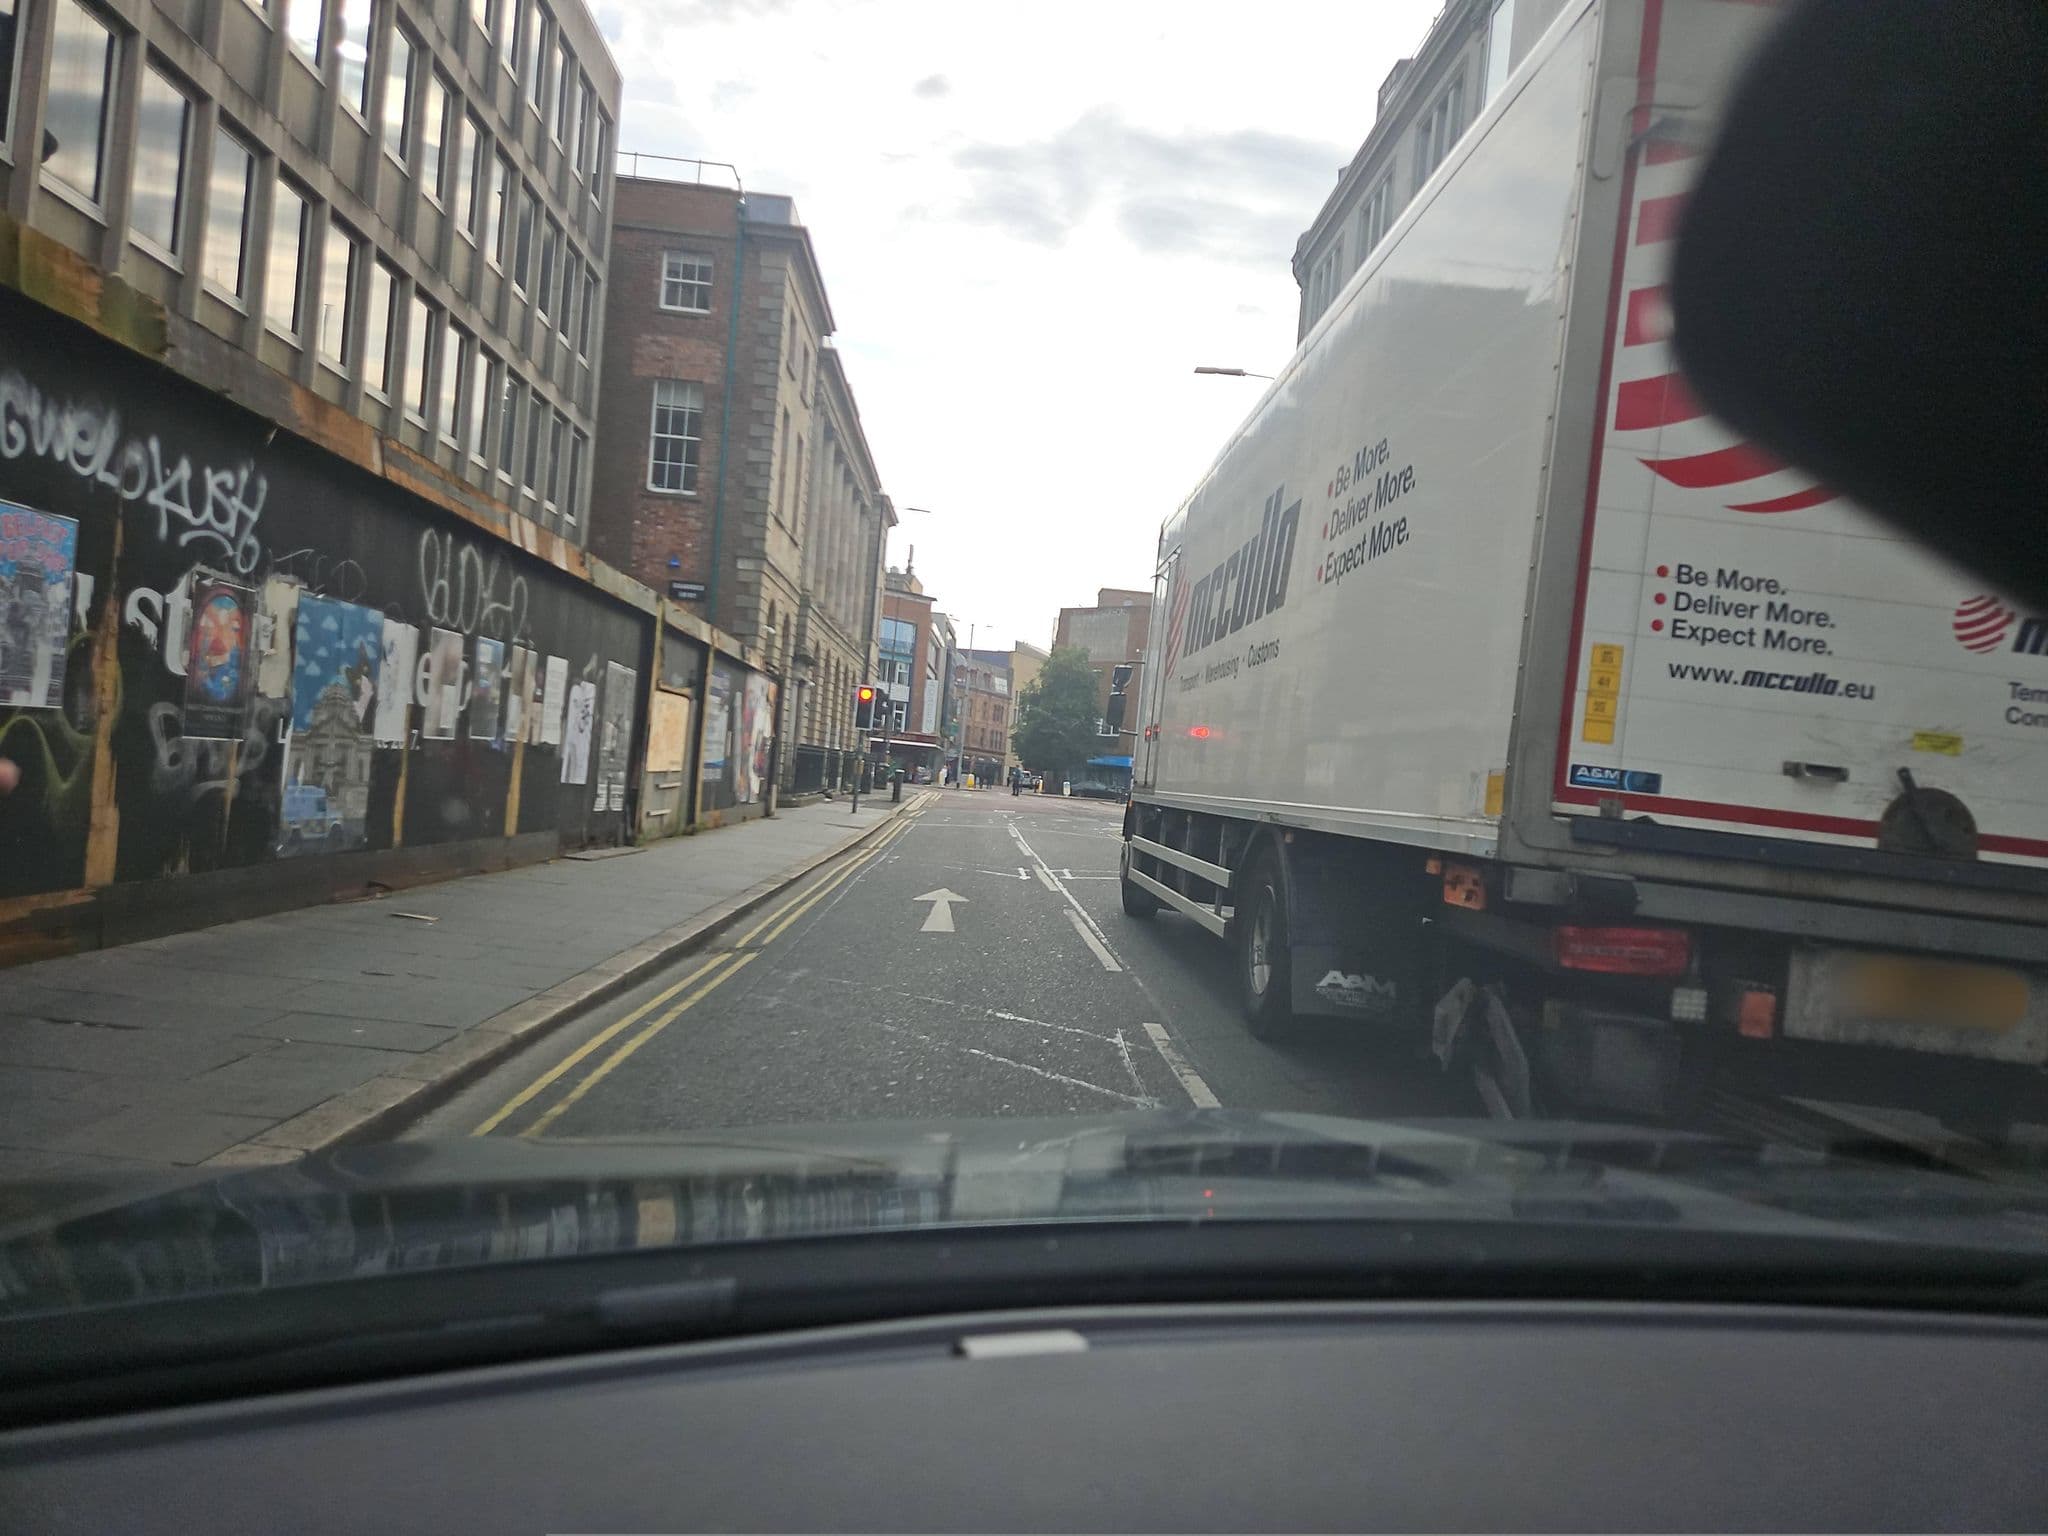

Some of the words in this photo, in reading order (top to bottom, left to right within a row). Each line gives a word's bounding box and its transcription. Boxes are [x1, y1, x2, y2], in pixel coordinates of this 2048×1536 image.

[1334, 465, 1351, 498] Be
[1353, 437, 1390, 485] More.
[1330, 492, 1373, 541] Deliver
[1374, 464, 1416, 512] More.
[1324, 533, 1367, 585] Expect
[1368, 516, 1409, 561] More.
[1676, 564, 1708, 586] Be
[1716, 567, 1787, 595] More.
[1674, 591, 1759, 619] Deliver
[1765, 601, 1836, 628] More.
[1247, 638, 1279, 668] Customs
[1671, 618, 1757, 646] Expect
[1763, 628, 1833, 655] More.
[1668, 662, 1875, 700] www.mcculla.eu
[1576, 766, 1620, 780] A&M
